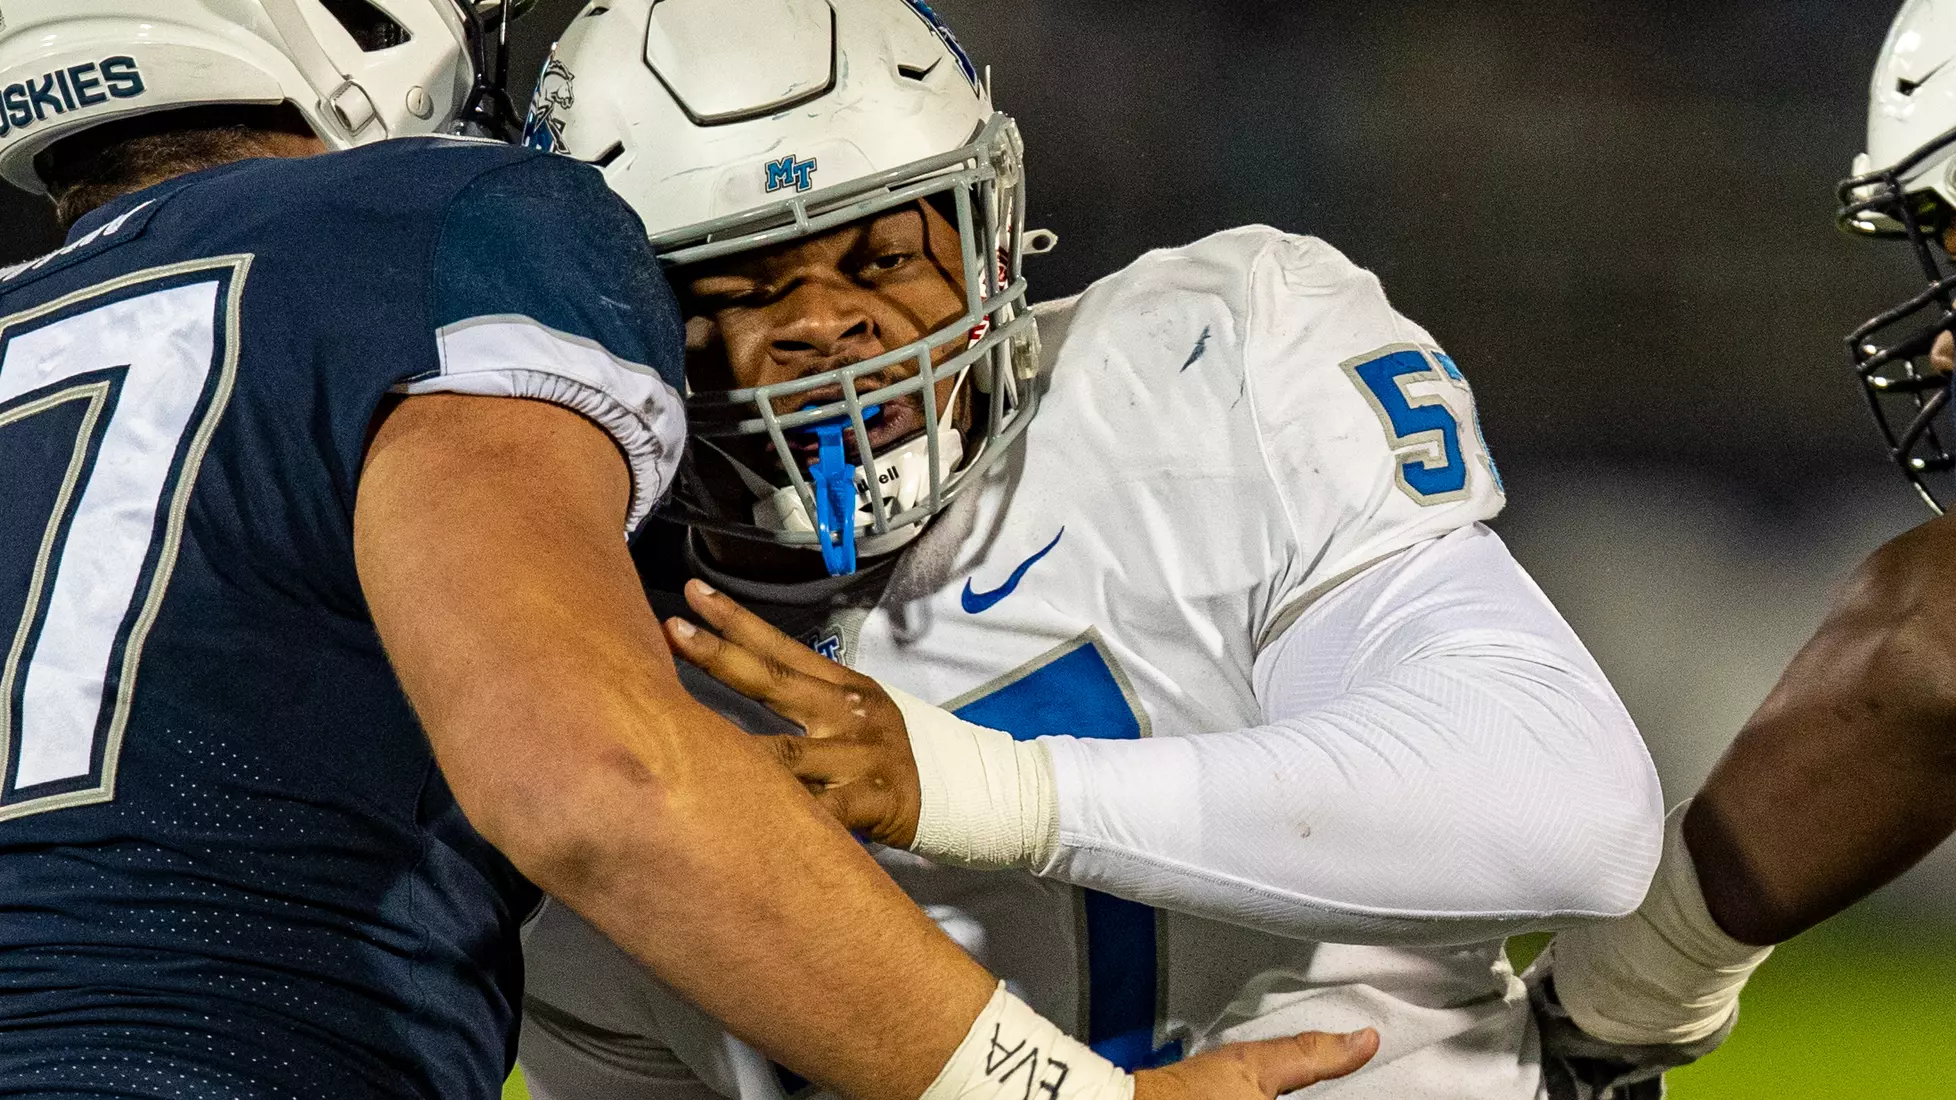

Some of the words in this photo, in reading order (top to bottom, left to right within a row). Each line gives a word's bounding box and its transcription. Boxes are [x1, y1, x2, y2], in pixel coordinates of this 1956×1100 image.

[764, 154, 818, 193] MT
[1338, 342, 1506, 507] 5
[0, 256, 254, 822] 7
